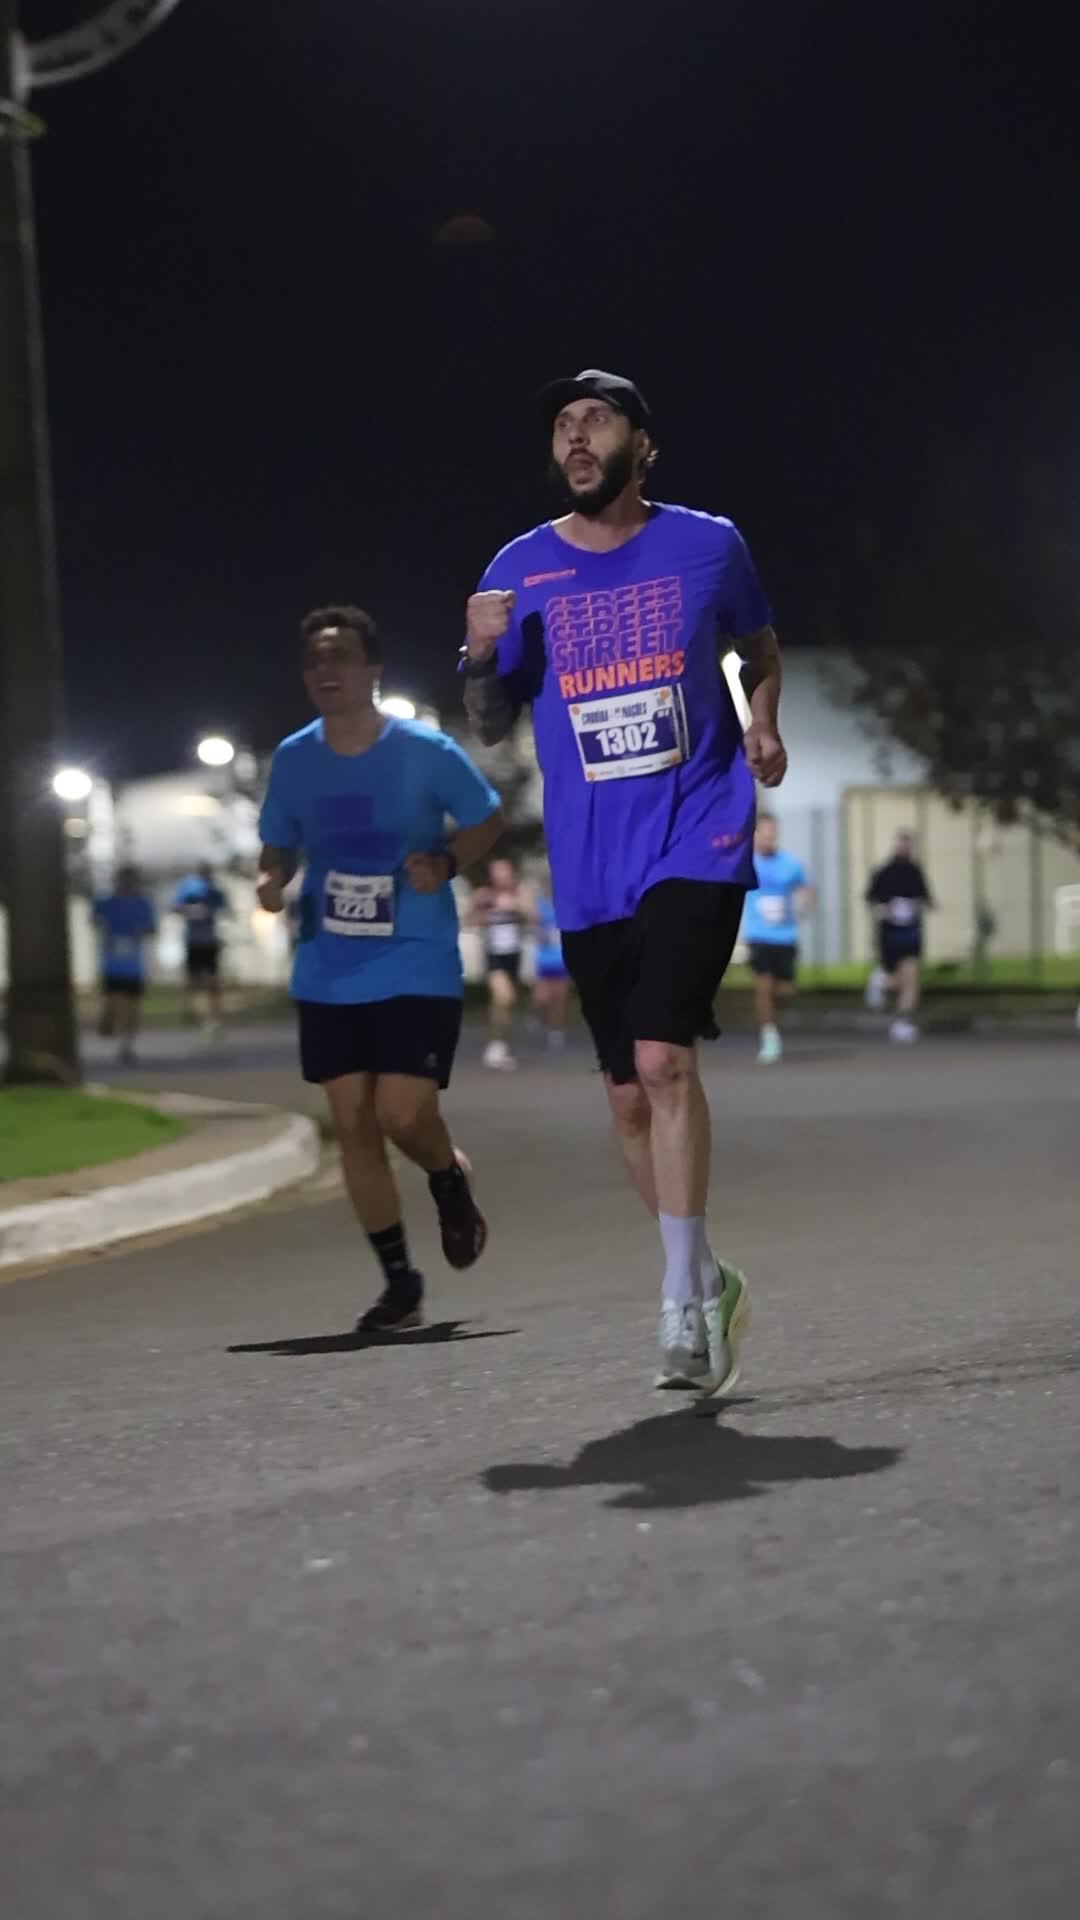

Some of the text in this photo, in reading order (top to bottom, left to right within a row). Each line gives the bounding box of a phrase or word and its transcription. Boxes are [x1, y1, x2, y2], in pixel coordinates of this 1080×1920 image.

[552, 618, 683, 674] STREET
[559, 650, 685, 699] RUNNERS
[595, 721, 659, 757] 1302
